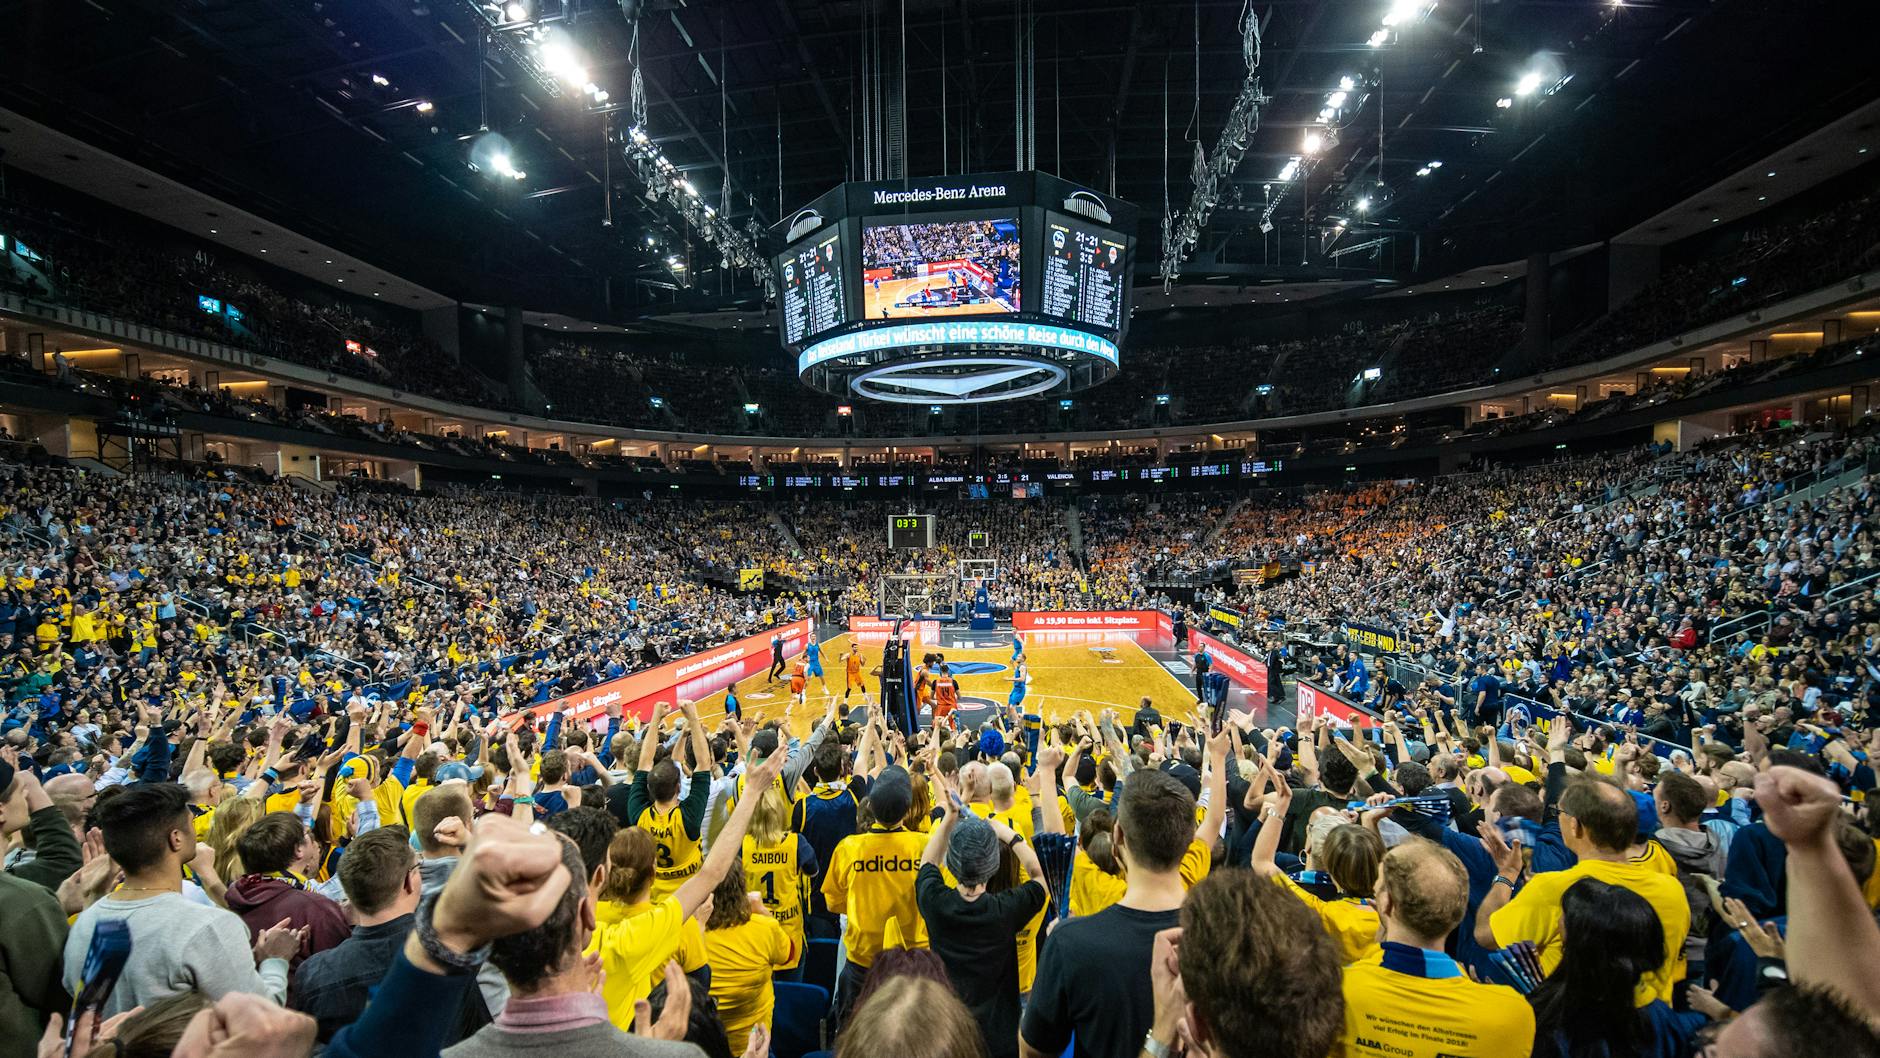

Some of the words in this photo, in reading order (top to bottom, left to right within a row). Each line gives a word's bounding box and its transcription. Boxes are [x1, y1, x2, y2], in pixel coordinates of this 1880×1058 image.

[874, 186, 965, 204] Mercedes-Benz
[968, 185, 1006, 198] Arena
[1080, 252, 1093, 265] 3:5
[893, 325, 946, 343] wünscht
[949, 325, 977, 340] eine
[982, 325, 1024, 341] schöne
[1027, 327, 1057, 343] Reise
[1059, 331, 1084, 348] durch
[1086, 335, 1099, 351] den
[1360, 630, 1376, 647] LEIB
[1377, 634, 1395, 652] UND
[656, 843, 674, 868] 3
[752, 853, 788, 864] SAIBOU
[854, 855, 922, 873] adidas
[663, 862, 698, 878] BERLIN
[760, 871, 779, 904] 1
[1365, 1013, 1377, 1021] Wir
[1379, 1016, 1415, 1029] wünschen
[1417, 1024, 1431, 1032] den
[1373, 1024, 1386, 1032] viel
[1387, 1026, 1408, 1037] Erfolg
[1410, 1031, 1419, 1039] im
[1421, 1033, 1444, 1043] Finale
[1356, 1037, 1382, 1050] ALBA
[1383, 1044, 1414, 1058] Group
